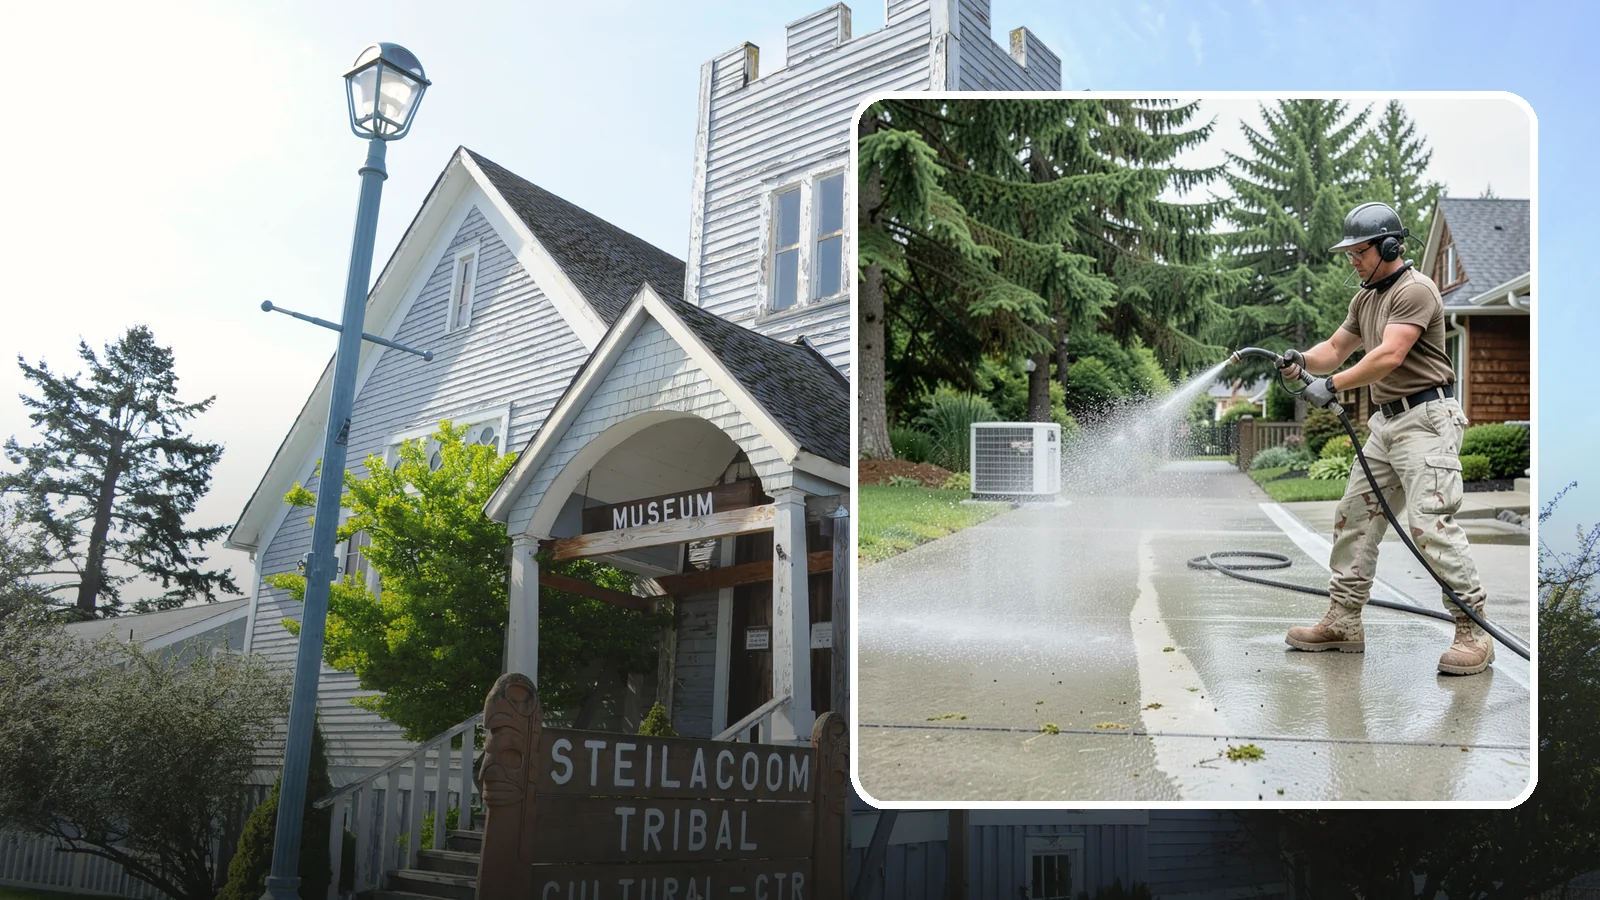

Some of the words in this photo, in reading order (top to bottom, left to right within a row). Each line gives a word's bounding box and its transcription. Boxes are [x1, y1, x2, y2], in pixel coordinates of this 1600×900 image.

[612, 491, 714, 531] MUSEUM
[551, 739, 809, 793] STEILACOOM
[615, 807, 758, 851] TRIBAL
